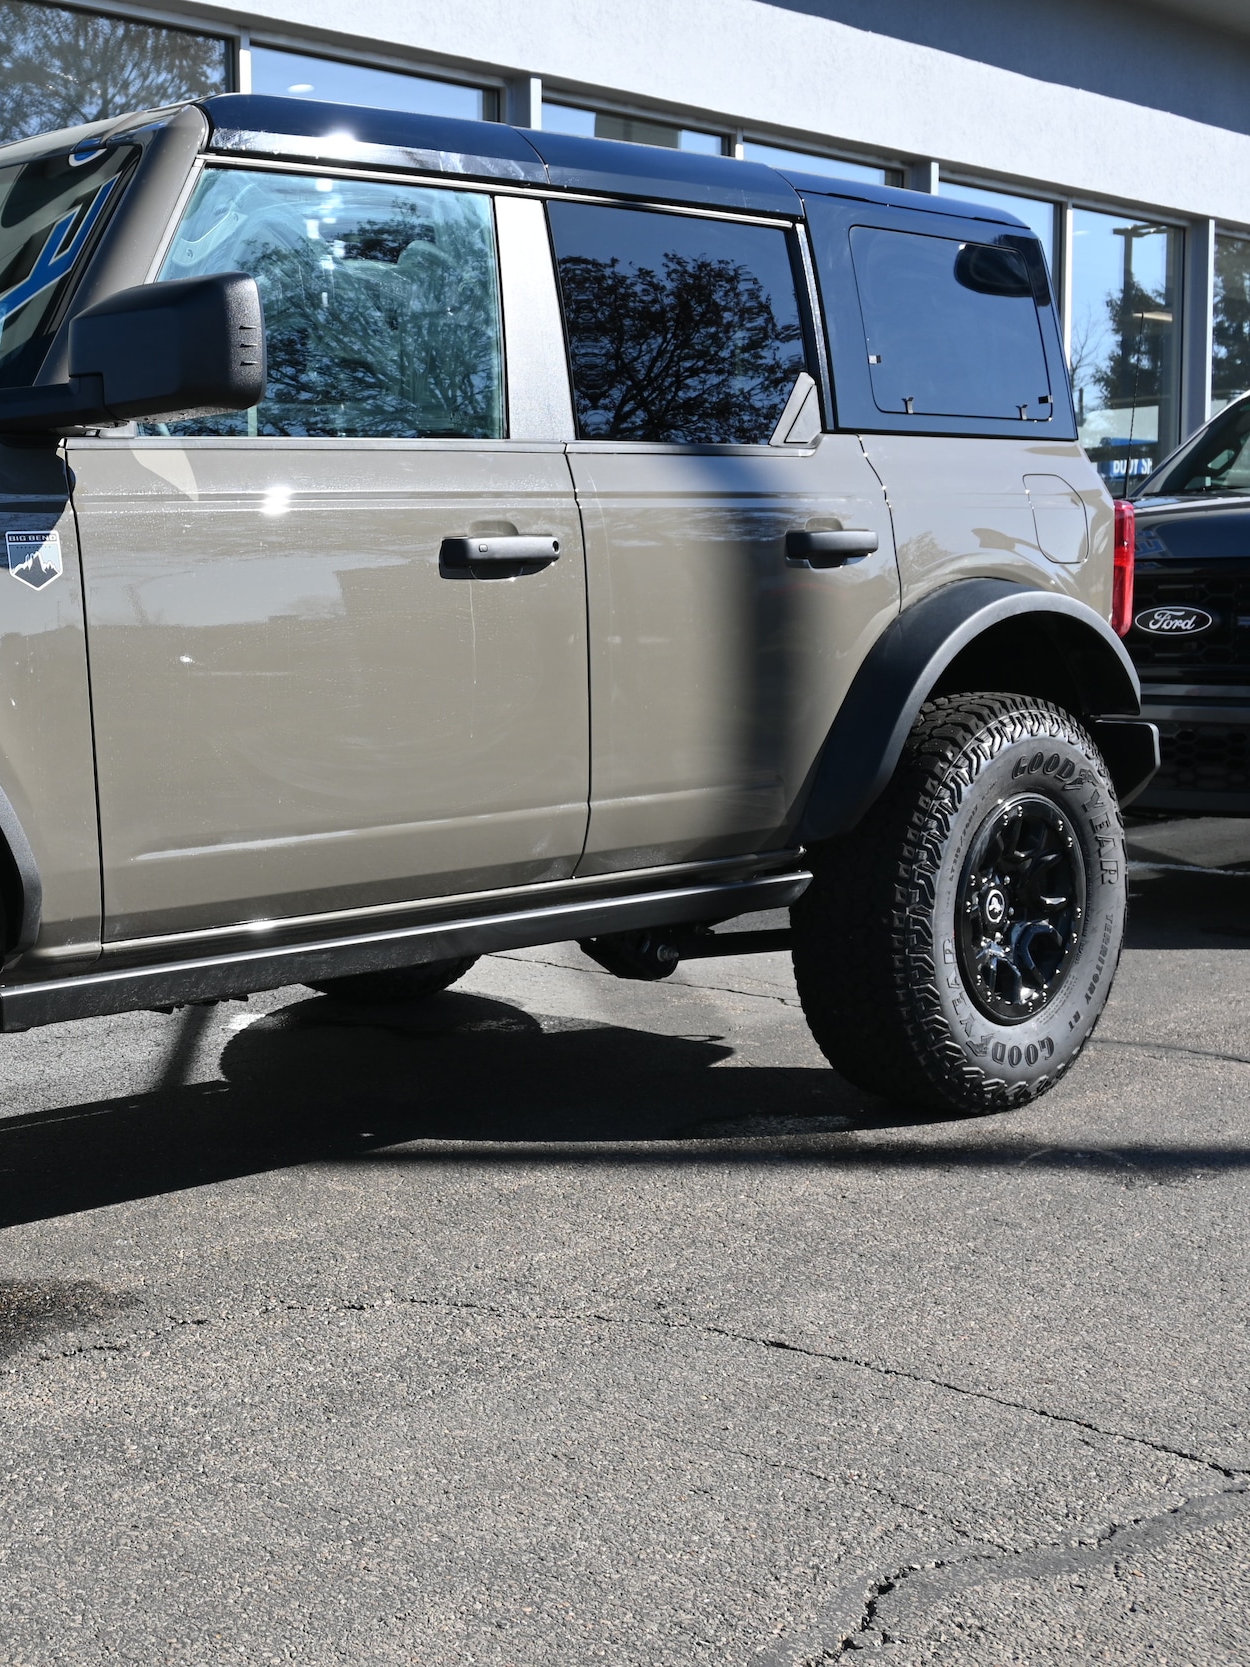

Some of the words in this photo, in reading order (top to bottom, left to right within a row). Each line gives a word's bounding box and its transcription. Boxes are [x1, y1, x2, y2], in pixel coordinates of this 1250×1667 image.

[9, 534, 26, 542] BIG
[29, 534, 57, 542] BEND
[1148, 610, 1197, 630] Ford
[1084, 913, 1114, 1005] TERRITORY
